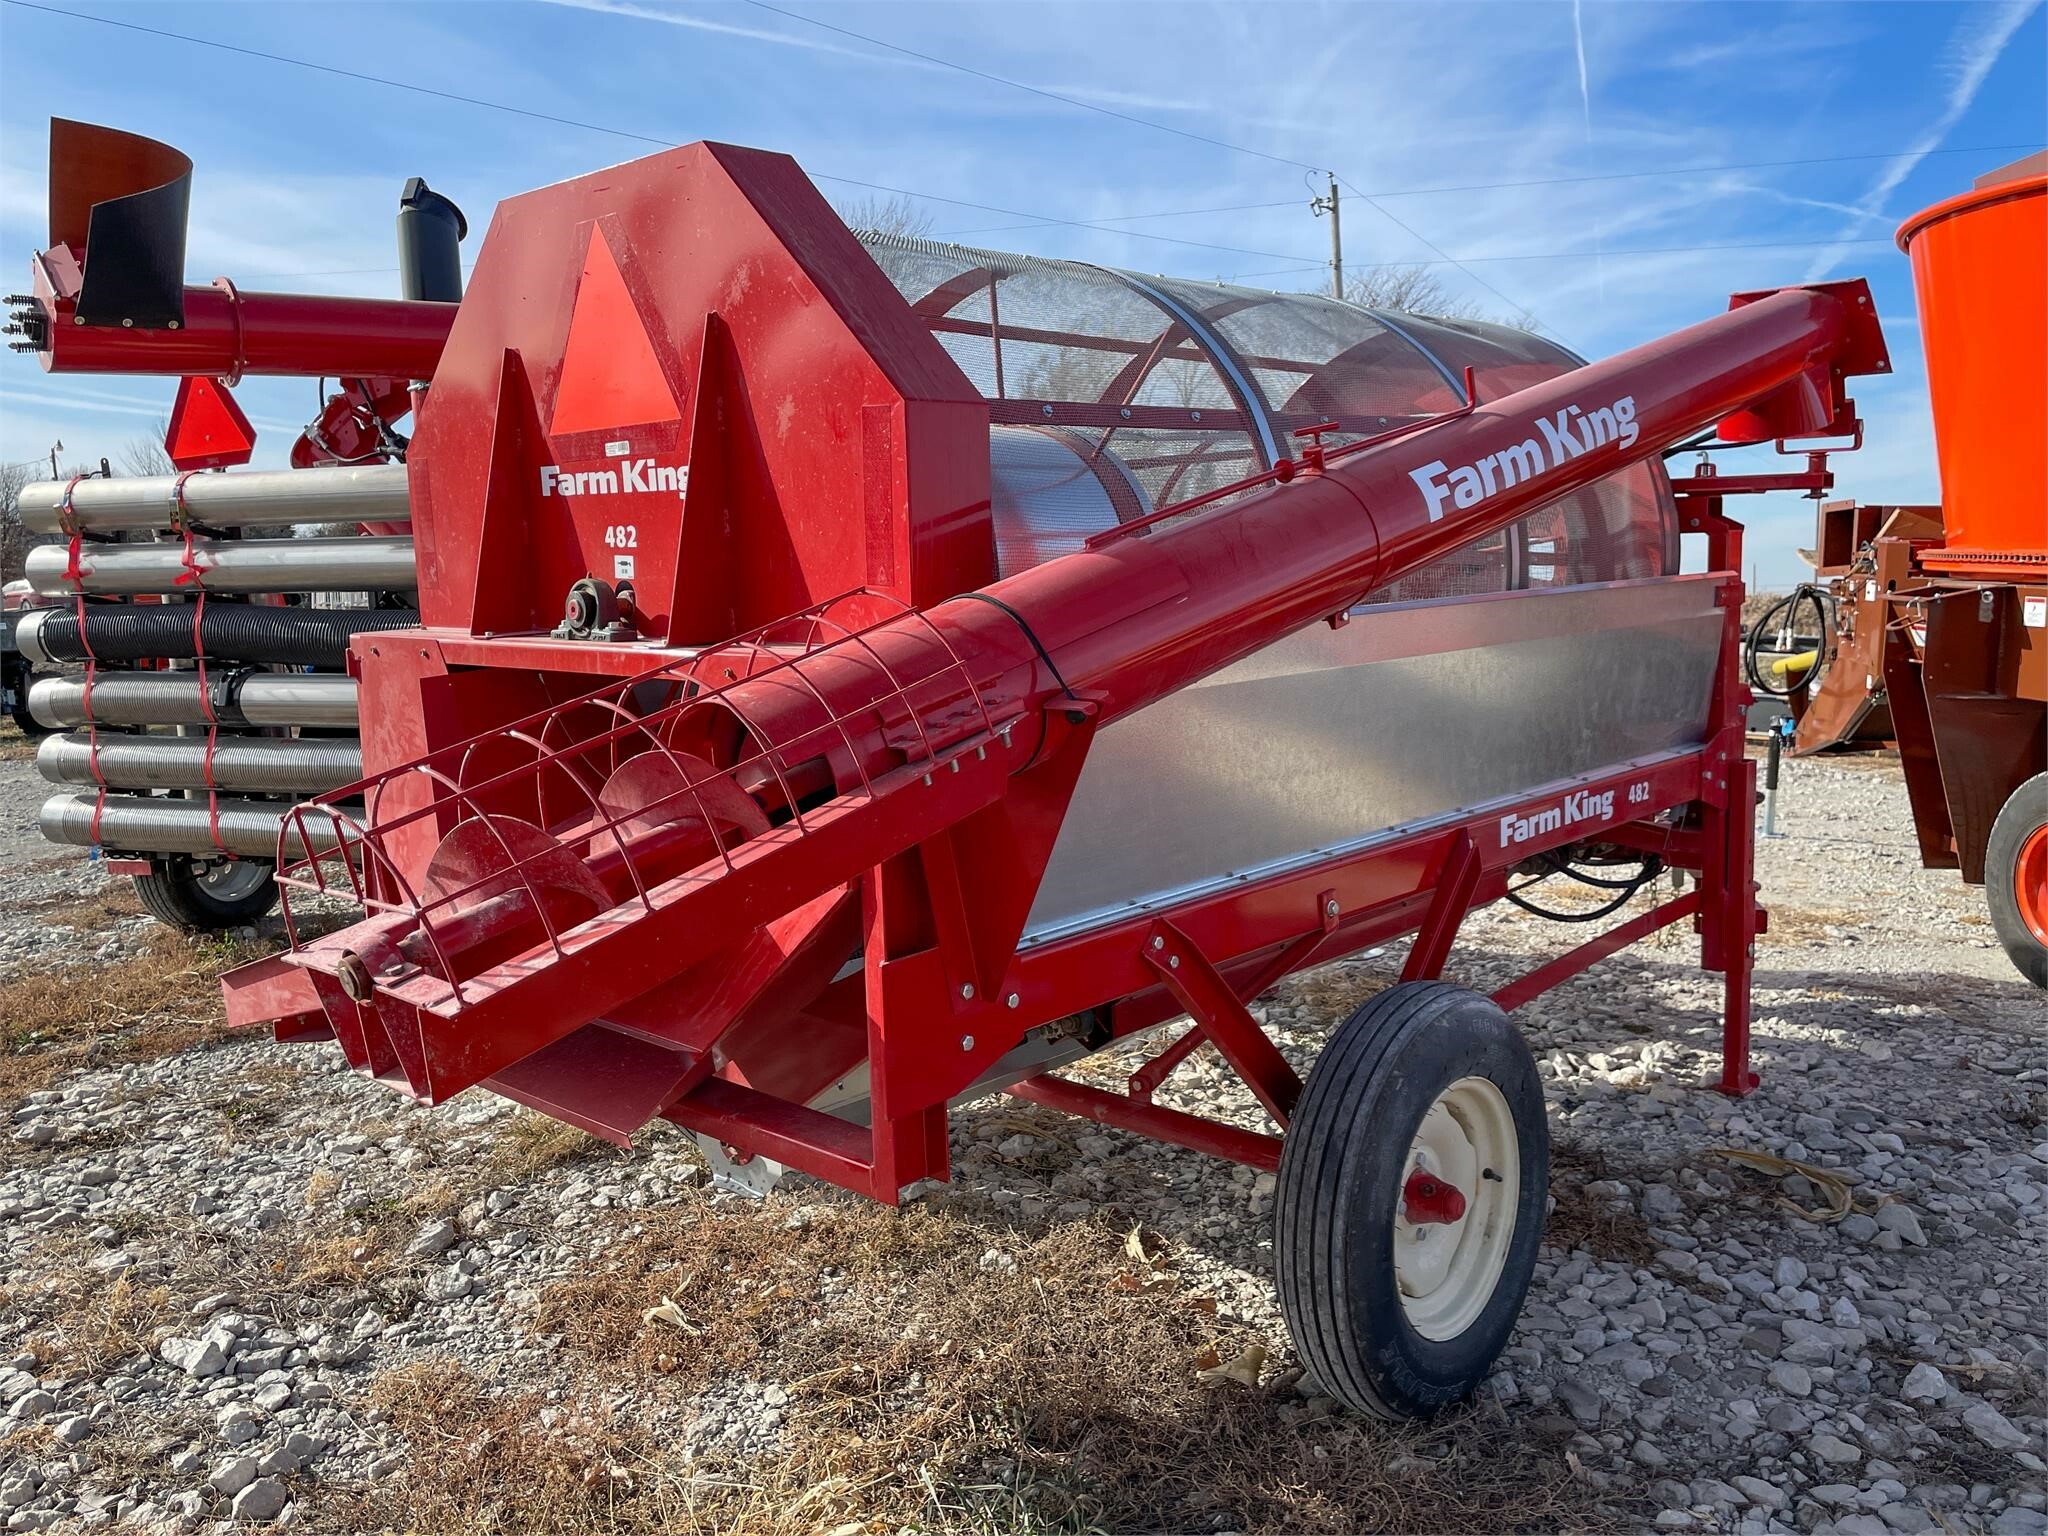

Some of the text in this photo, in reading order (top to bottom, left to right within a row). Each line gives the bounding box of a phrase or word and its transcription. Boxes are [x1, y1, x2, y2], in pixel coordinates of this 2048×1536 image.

[540, 458, 689, 500] Farm King
[1408, 396, 1639, 523] Farm King
[604, 525, 638, 548] 482
[1500, 781, 1650, 848] Farm King 482
